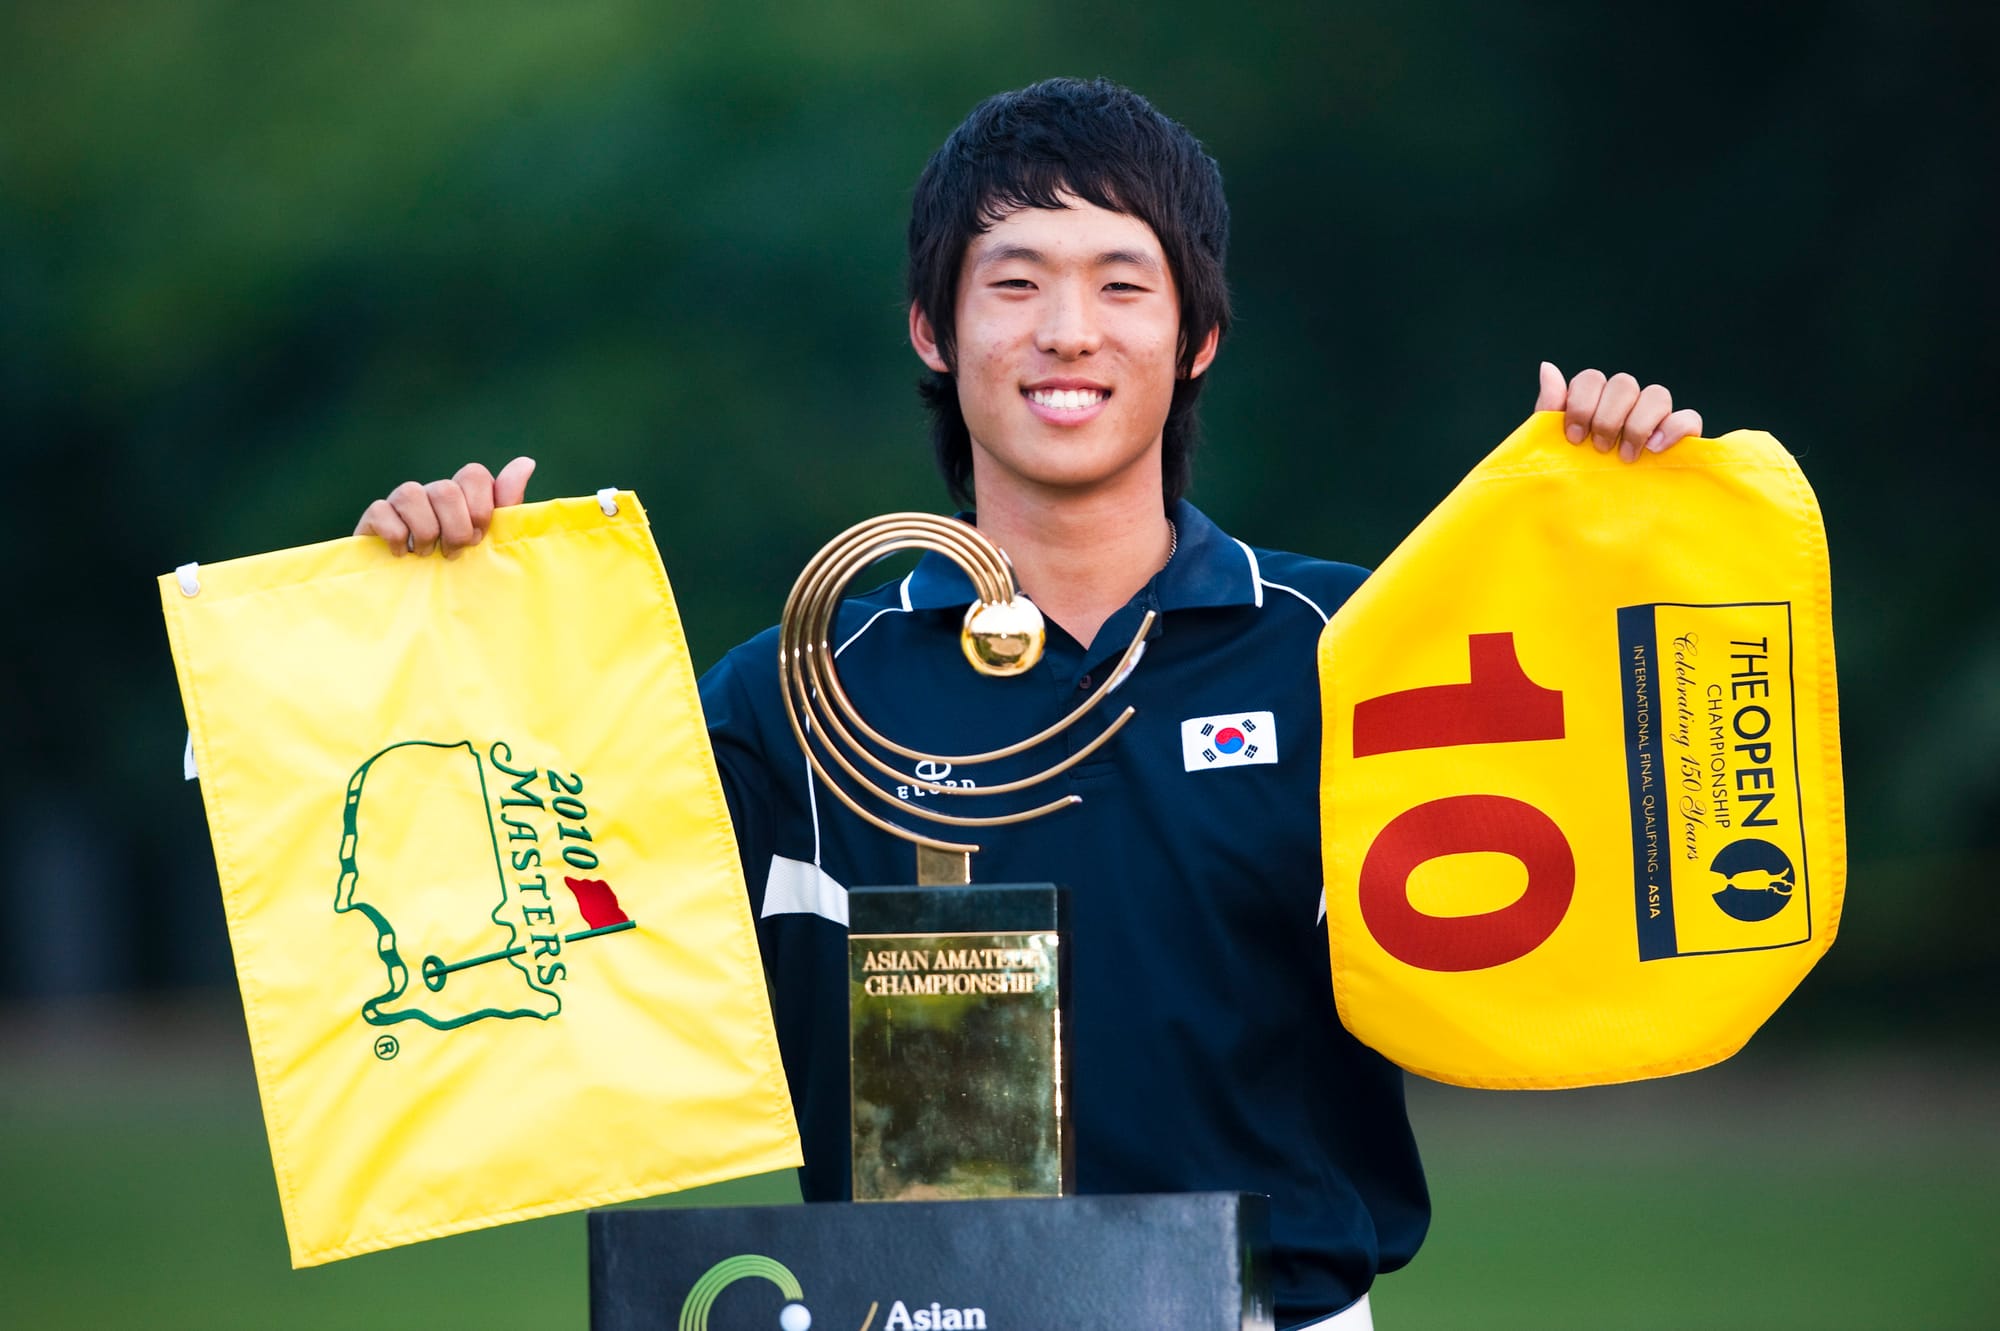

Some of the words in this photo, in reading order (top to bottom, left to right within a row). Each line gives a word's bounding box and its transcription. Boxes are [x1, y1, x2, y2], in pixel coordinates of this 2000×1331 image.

[1633, 644, 1651, 751] INTERNATIONAL
[1669, 631, 1699, 748] Celebrating
[1730, 637, 1770, 701] THE
[1640, 753, 1653, 793] FINAL
[1680, 754, 1703, 793] 150
[1706, 684, 1731, 829] CHAMPIONSHIP
[1732, 705, 1779, 828] OPEN
[547, 768, 600, 871] 2010
[1352, 631, 1576, 973] 10
[1640, 794, 1660, 874] QUALIFYING
[1678, 795, 1709, 862] Years
[489, 741, 568, 986] MASTERS
[1648, 884, 1661, 919] ASIA
[862, 950, 929, 972] ASIAN
[864, 972, 1038, 996] CHAMPIONSHIP
[884, 1300, 988, 1331] Asian
